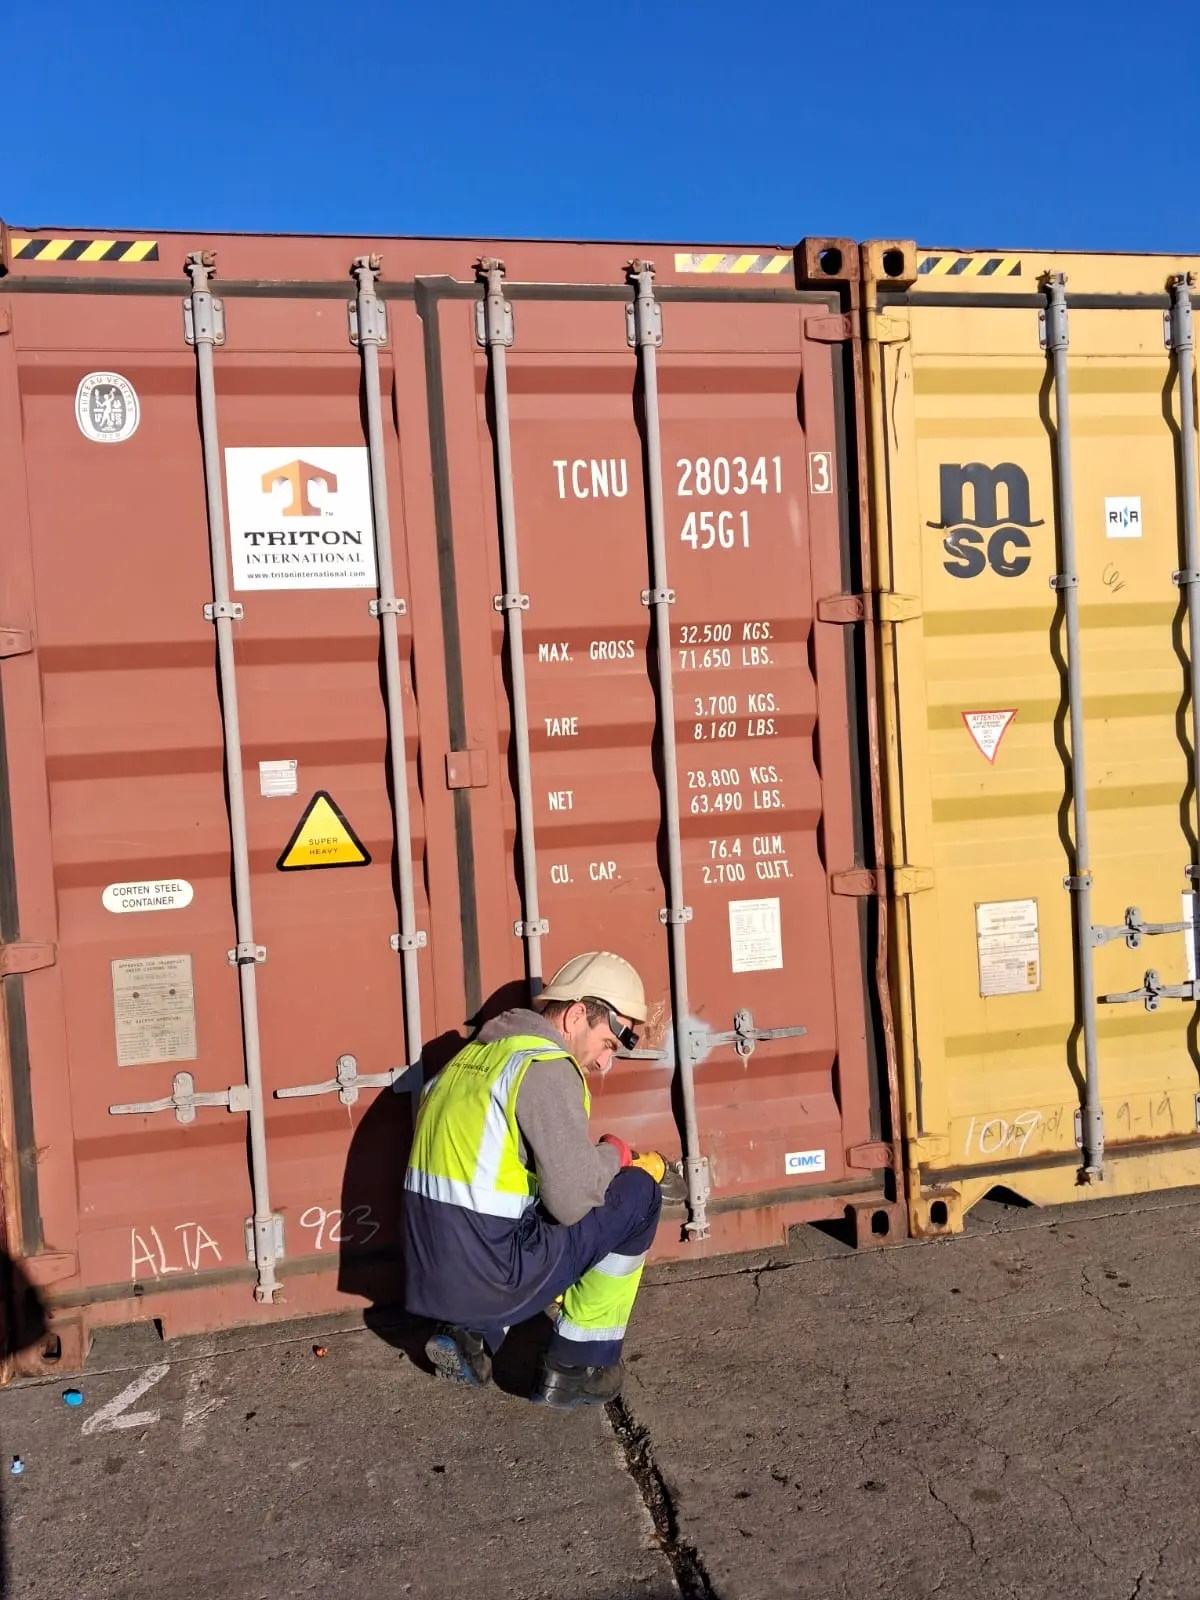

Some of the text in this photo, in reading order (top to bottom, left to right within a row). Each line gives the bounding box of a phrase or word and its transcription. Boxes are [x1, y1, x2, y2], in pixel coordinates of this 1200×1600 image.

[81, 377, 134, 412] BUREAU VERITAS
[553, 453, 831, 499] TCNU 280341 3
[244, 531, 363, 546] TRITON
[680, 510, 750, 549] 45G1
[246, 552, 364, 564] INTERNATIONAL
[247, 570, 366, 579] www.tritoninternational.com
[742, 622, 774, 641] KGS.
[538, 640, 635, 662] MAX. GROSS
[742, 646, 774, 666] LBS.
[748, 692, 781, 714] KGS.
[544, 717, 579, 737] TARE
[747, 718, 778, 737] LBS.
[750, 766, 783, 785] KGS.
[548, 791, 574, 811] NET
[753, 789, 786, 810] LBS.
[309, 837, 338, 846] SUPER
[310, 847, 338, 855] HEAVY
[708, 835, 786, 859] 76.4 CU.M.
[550, 861, 622, 884] CU. CAP.
[113, 883, 183, 896] CORTEN STEEL
[122, 896, 175, 908] CONTAINER
[789, 1155, 822, 1167] CIMC
[300, 1205, 380, 1250] 923
[131, 1222, 223, 1279] ALTA
